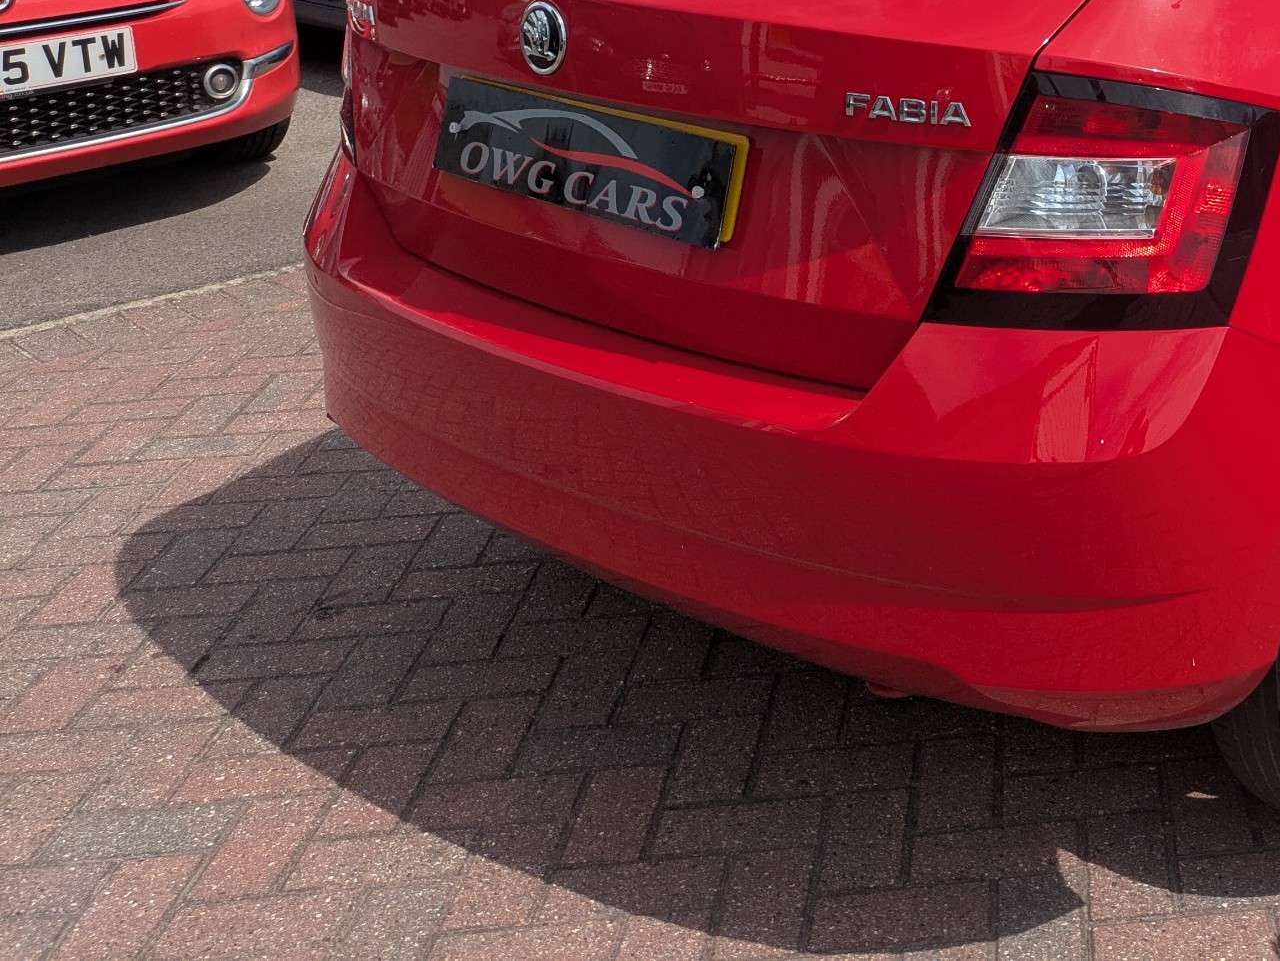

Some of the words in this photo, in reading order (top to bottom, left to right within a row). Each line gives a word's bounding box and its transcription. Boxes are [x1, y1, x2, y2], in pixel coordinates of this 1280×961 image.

[42, 32, 126, 79] VTW
[845, 92, 972, 127] FABIA
[460, 141, 557, 194] OWG
[563, 171, 688, 232] CARS
